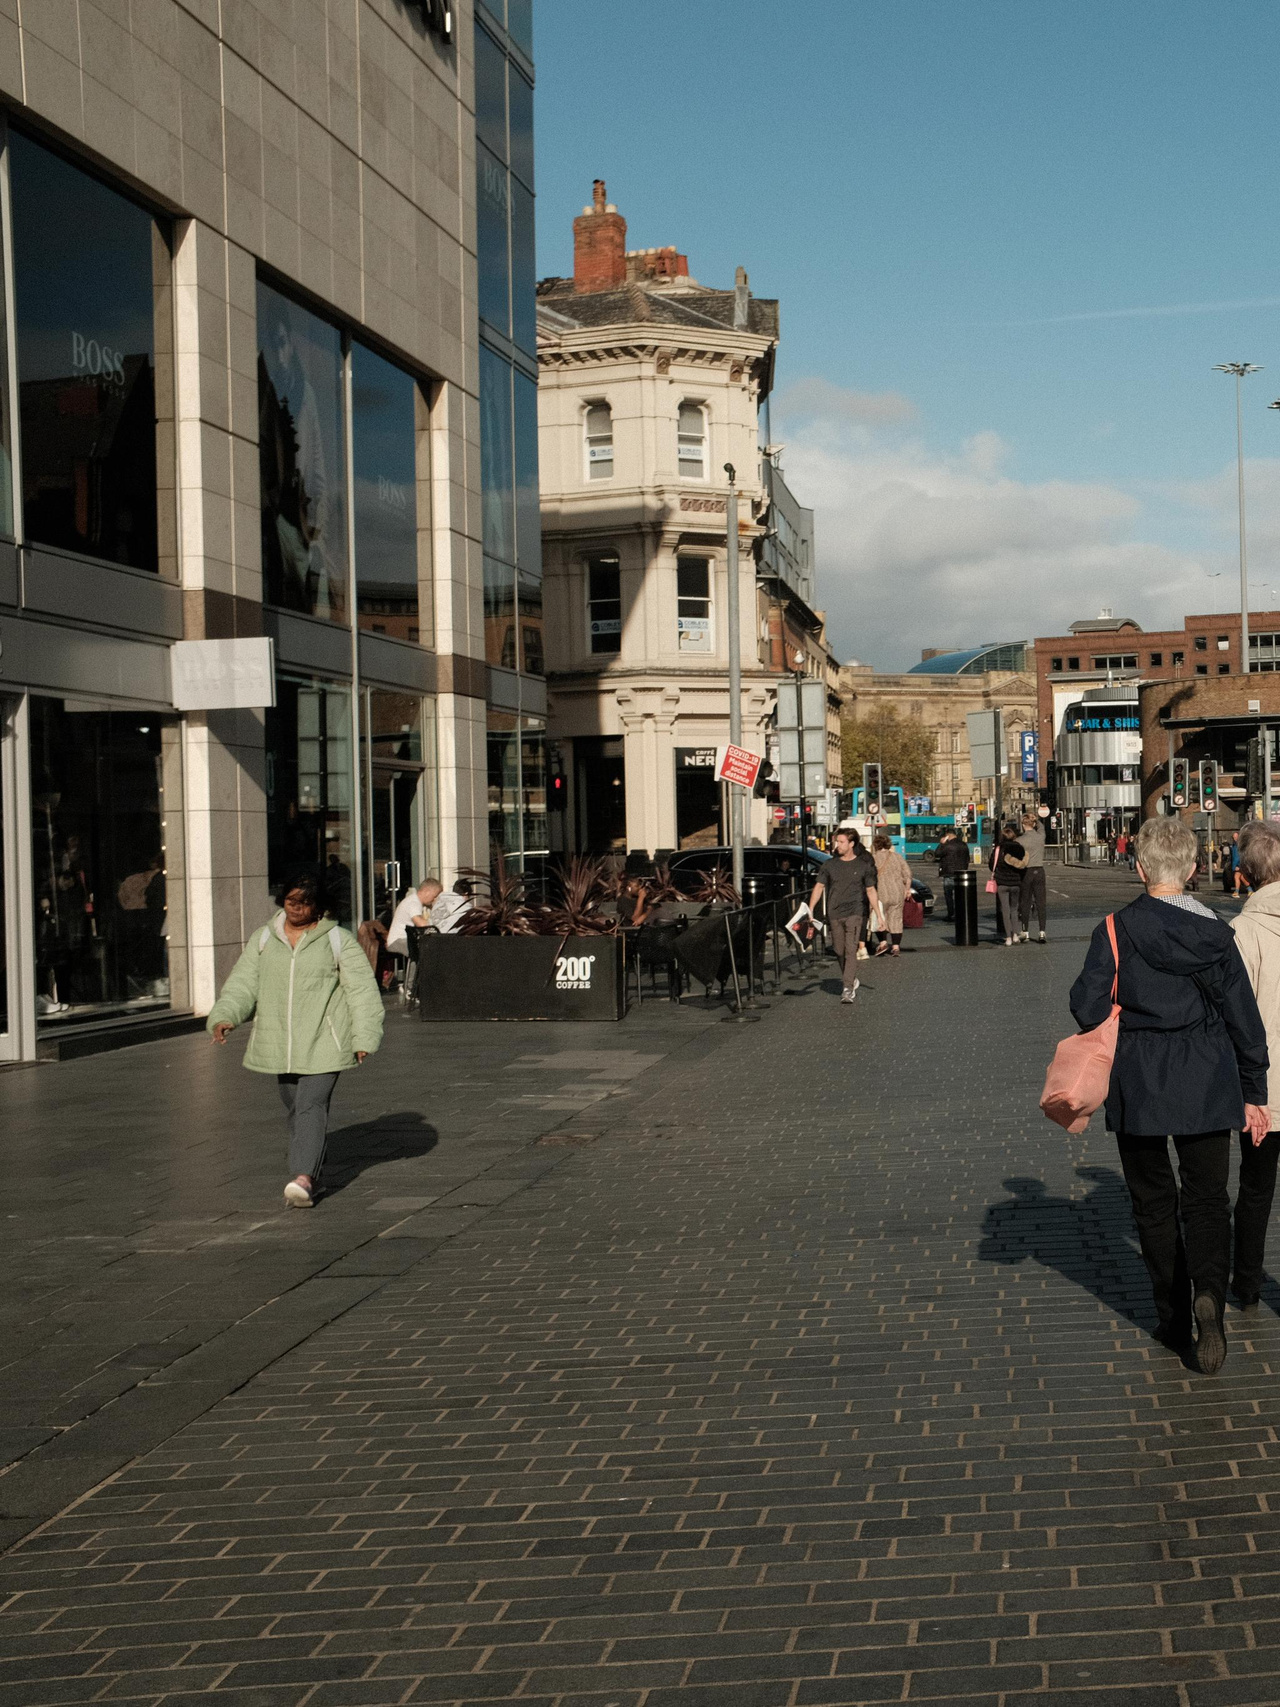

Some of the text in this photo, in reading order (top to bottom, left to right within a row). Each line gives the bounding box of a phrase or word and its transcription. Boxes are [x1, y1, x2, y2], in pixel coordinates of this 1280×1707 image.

[71, 330, 126, 386] BOSS
[378, 474, 407, 510] BOSS
[1102, 717, 1110, 729] &
[1024, 736, 1034, 752] P
[684, 756, 716, 766] NER
[728, 747, 759, 763] COVID-19
[728, 757, 754, 772] Maintain
[730, 766, 748, 777] social
[724, 770, 750, 784] distance
[556, 981, 591, 989] COFFEE
